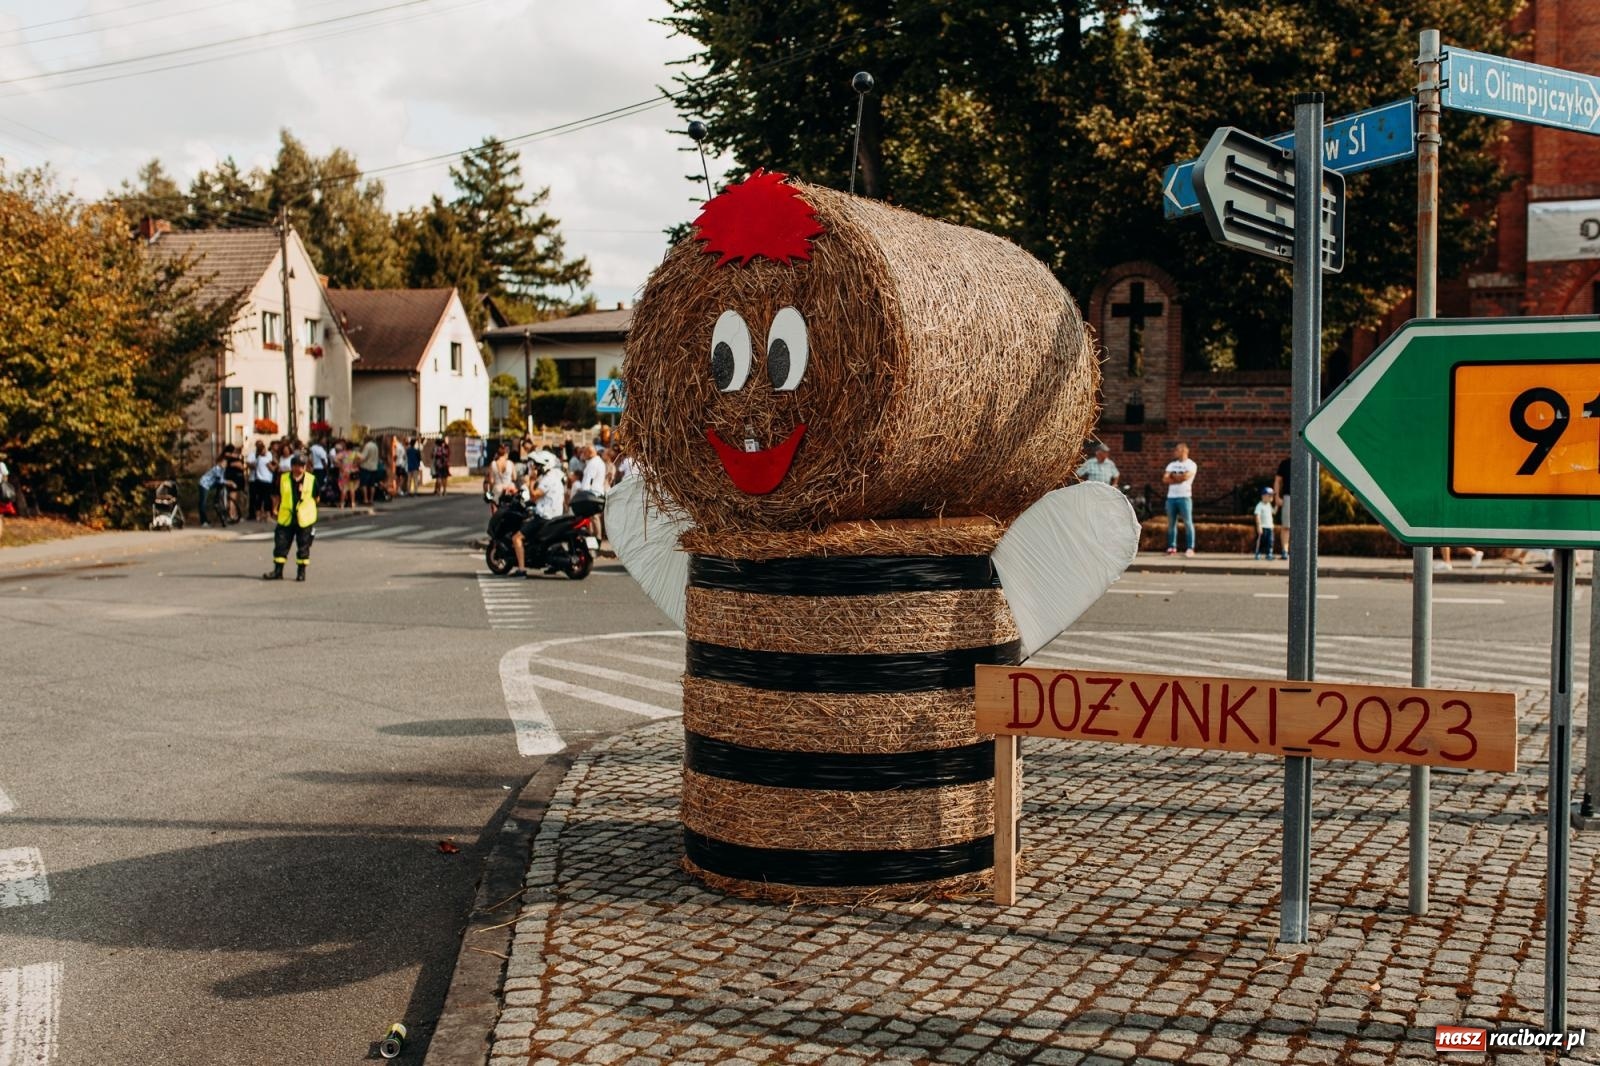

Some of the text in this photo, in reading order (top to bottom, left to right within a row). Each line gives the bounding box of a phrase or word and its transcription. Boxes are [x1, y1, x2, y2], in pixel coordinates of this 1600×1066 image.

[1458, 64, 1594, 122] ul. Olimpijczyka
[1309, 691, 1478, 762] 2023
